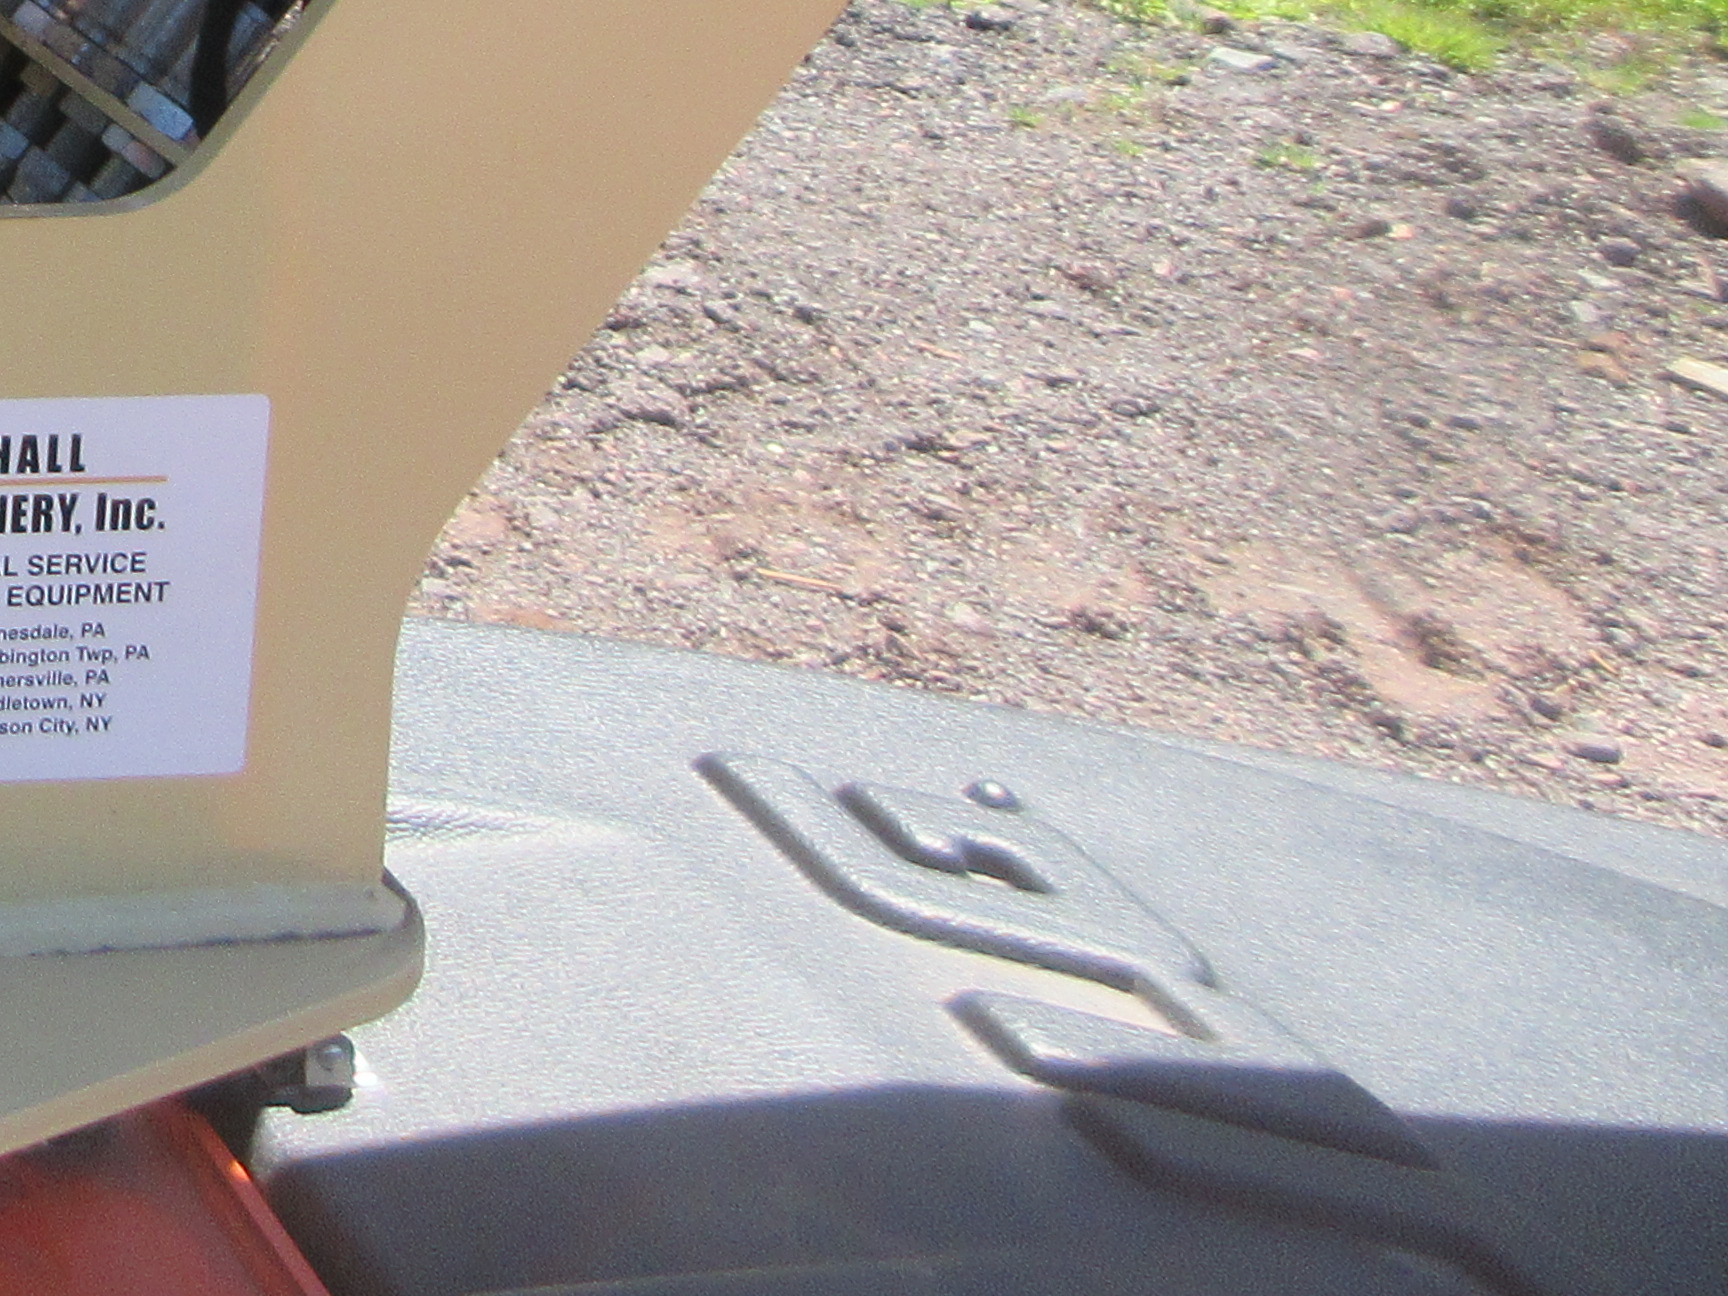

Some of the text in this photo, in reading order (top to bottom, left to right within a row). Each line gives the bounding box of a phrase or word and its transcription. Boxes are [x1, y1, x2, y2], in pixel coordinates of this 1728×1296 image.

[95, 492, 165, 531] Inc.
[27, 552, 147, 576] SERVICE
[7, 581, 170, 607] EQUIPMENT
[81, 622, 106, 638] PA
[76, 645, 118, 665] Twp,
[125, 645, 150, 660] PA
[85, 669, 111, 685] PA
[80, 693, 106, 708] NY
[39, 717, 79, 736] City,
[86, 716, 112, 731] NY
